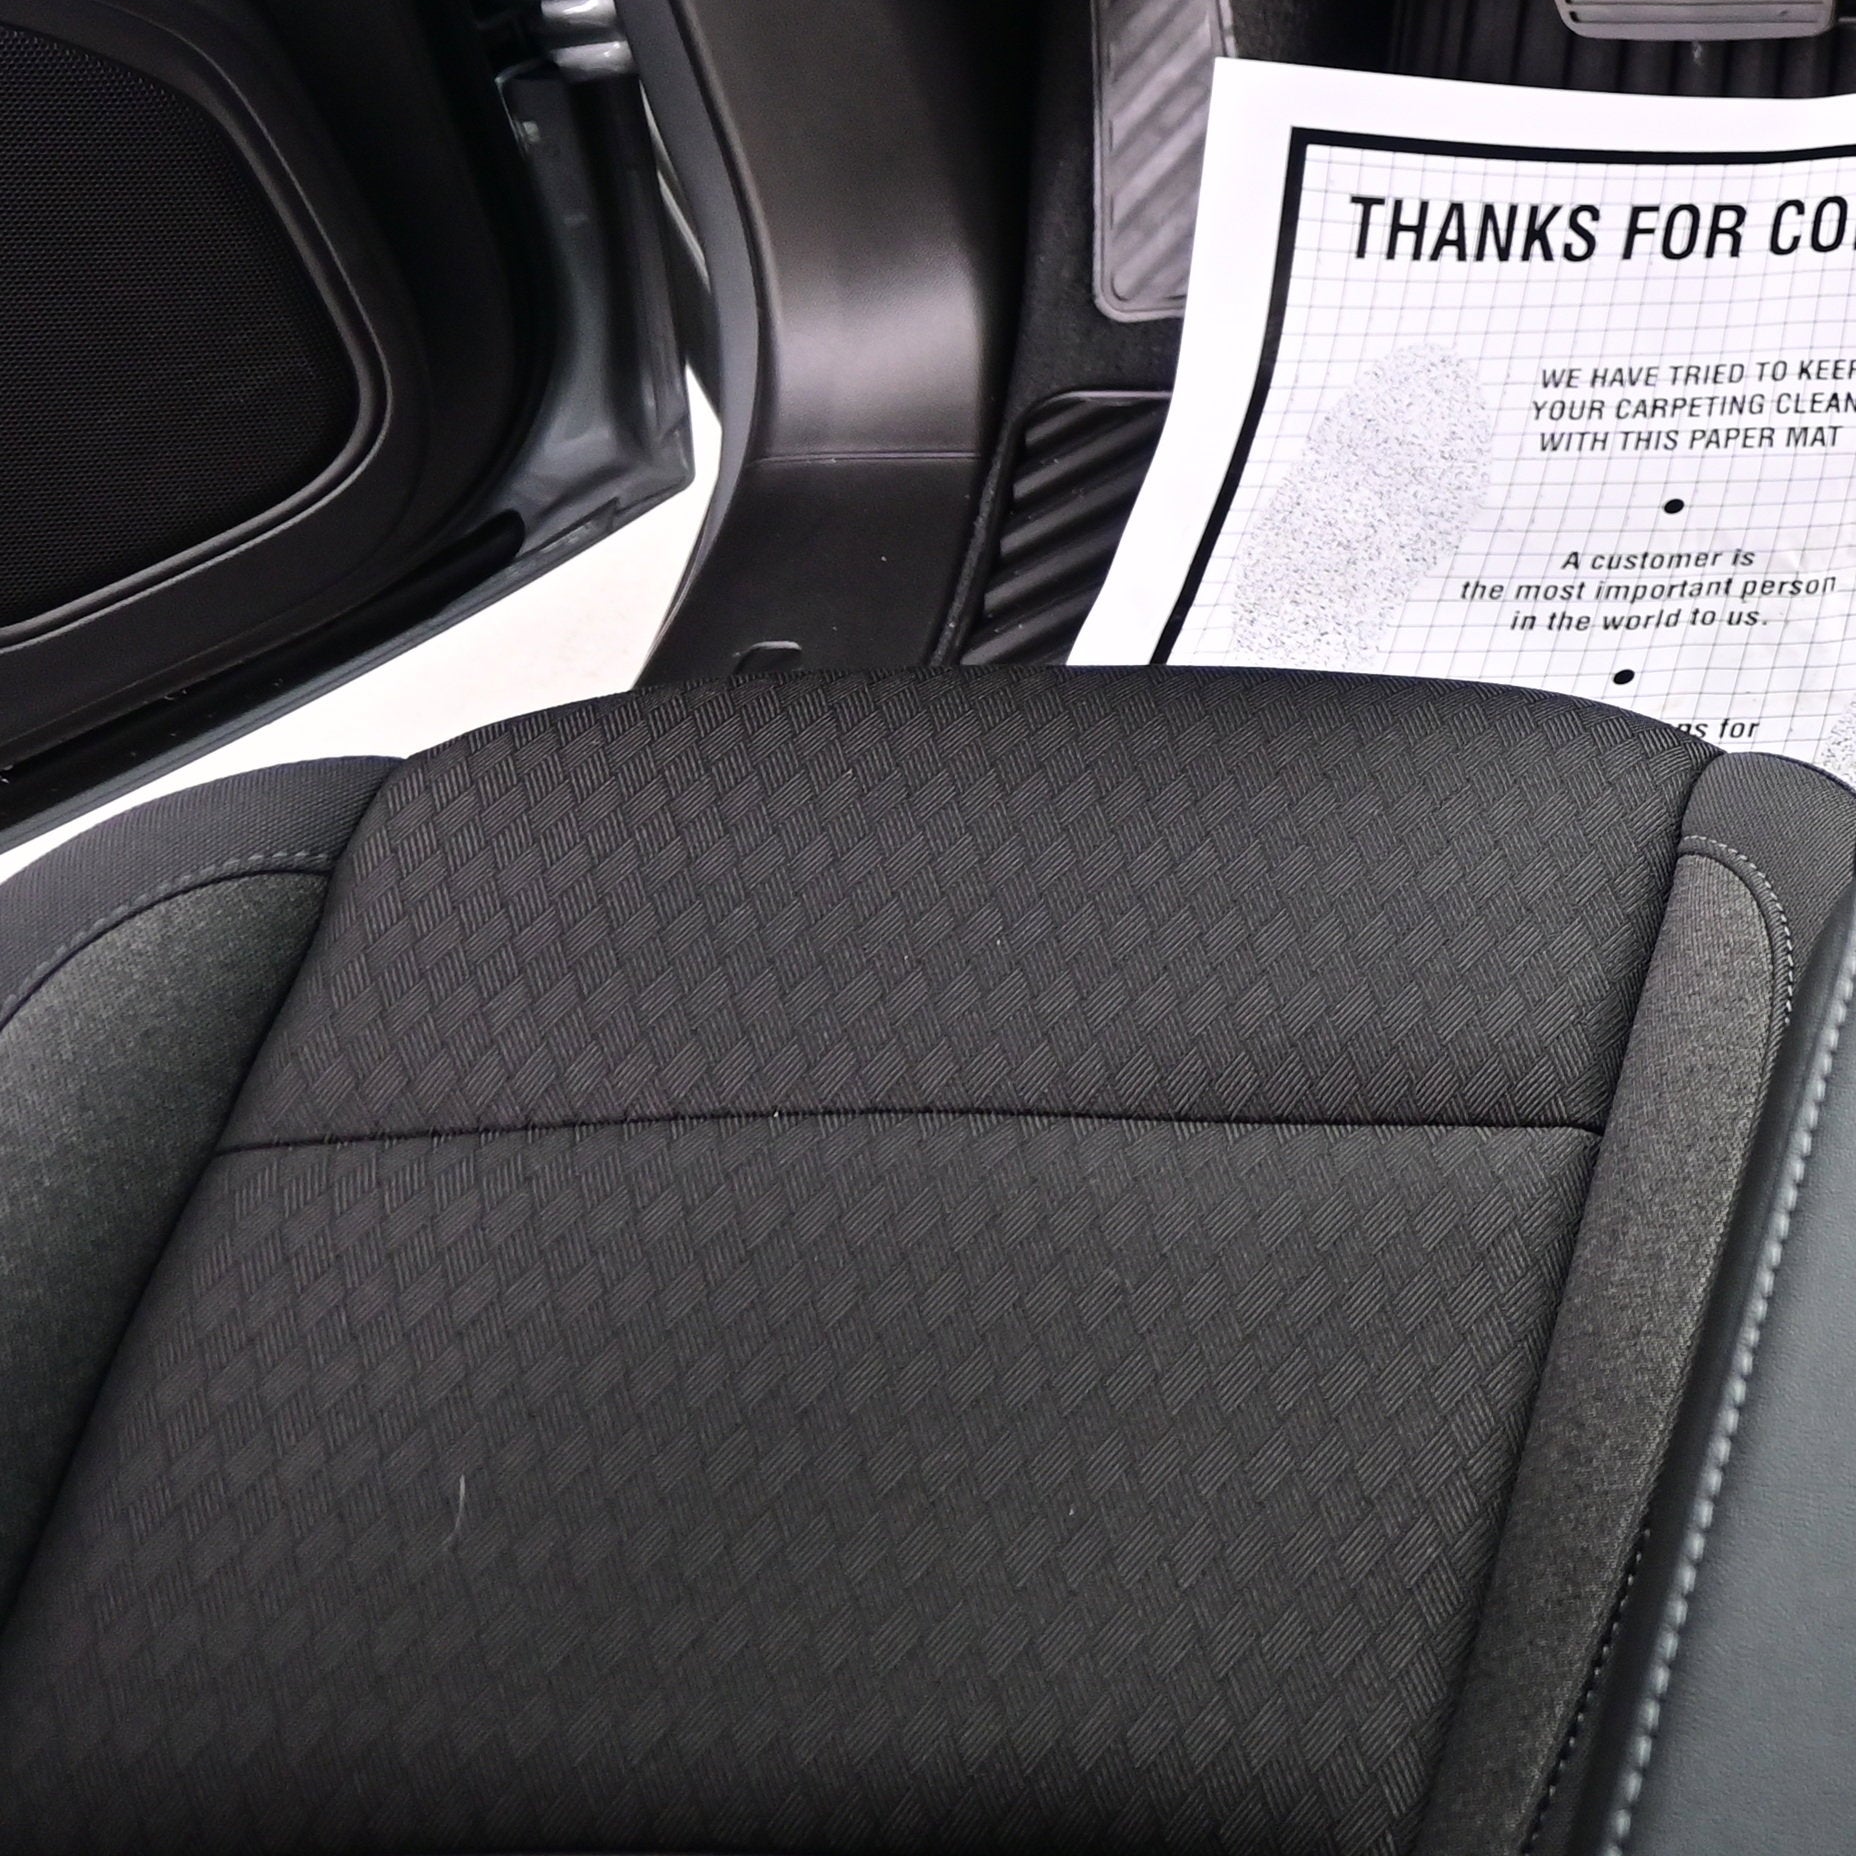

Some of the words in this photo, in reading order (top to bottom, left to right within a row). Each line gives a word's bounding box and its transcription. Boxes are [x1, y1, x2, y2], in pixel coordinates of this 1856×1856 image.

[1351, 196, 1600, 262] THANKS
[1622, 204, 1746, 260] FOR
[1543, 369, 1580, 388] WE
[1591, 367, 1658, 387] HAVE
[1671, 364, 1744, 385] TRIED
[1758, 361, 1787, 381] TO
[1533, 400, 1604, 420] YOUR
[1616, 394, 1764, 419] CARPETING
[1541, 432, 1609, 451] WITH
[1621, 430, 1678, 450] THIS
[1690, 427, 1775, 449] PAPER
[1787, 426, 1842, 446] MAT
[1562, 552, 1579, 569] A
[1592, 552, 1722, 570] customer
[1733, 549, 1754, 565] is
[1461, 581, 1504, 600] the
[1516, 582, 1585, 600] most
[1596, 578, 1732, 604] important
[1740, 577, 1836, 600] person
[1510, 615, 1537, 630] in
[1548, 612, 1590, 630] the
[1603, 609, 1681, 630] world
[1691, 608, 1715, 625] to
[1727, 611, 1768, 625] us.
[1720, 718, 1759, 738] for
